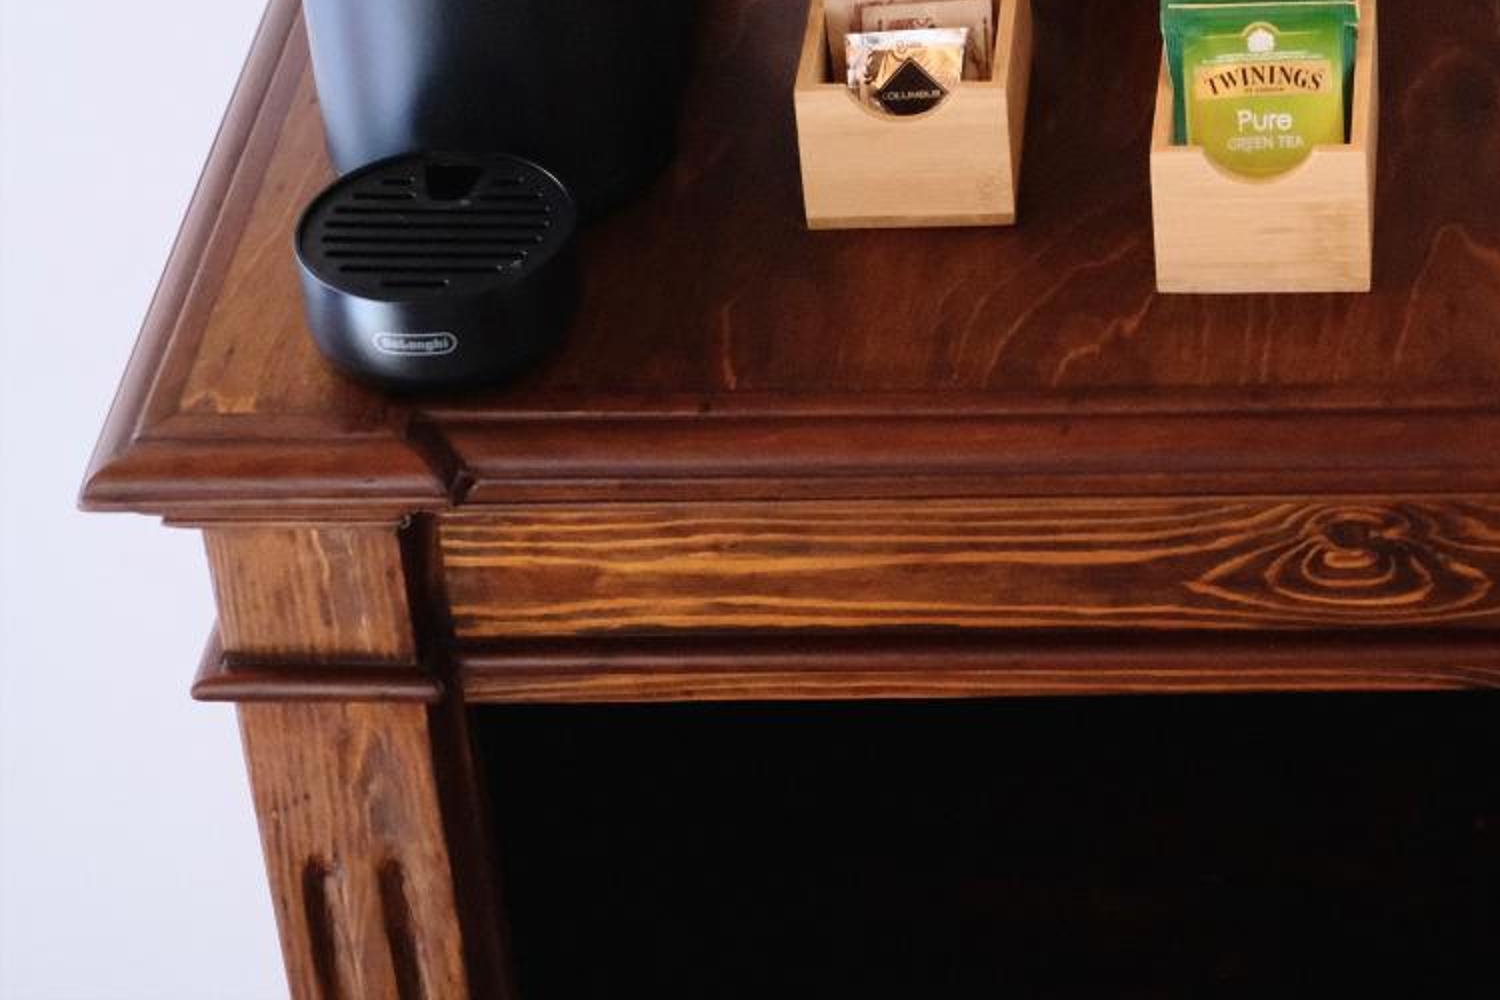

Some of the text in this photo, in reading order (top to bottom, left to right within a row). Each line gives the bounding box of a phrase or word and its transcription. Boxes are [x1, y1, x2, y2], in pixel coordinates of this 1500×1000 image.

[1204, 64, 1324, 96] TWININGS
[1236, 108, 1293, 132] Pure
[1227, 134, 1304, 151] GREEN TEA
